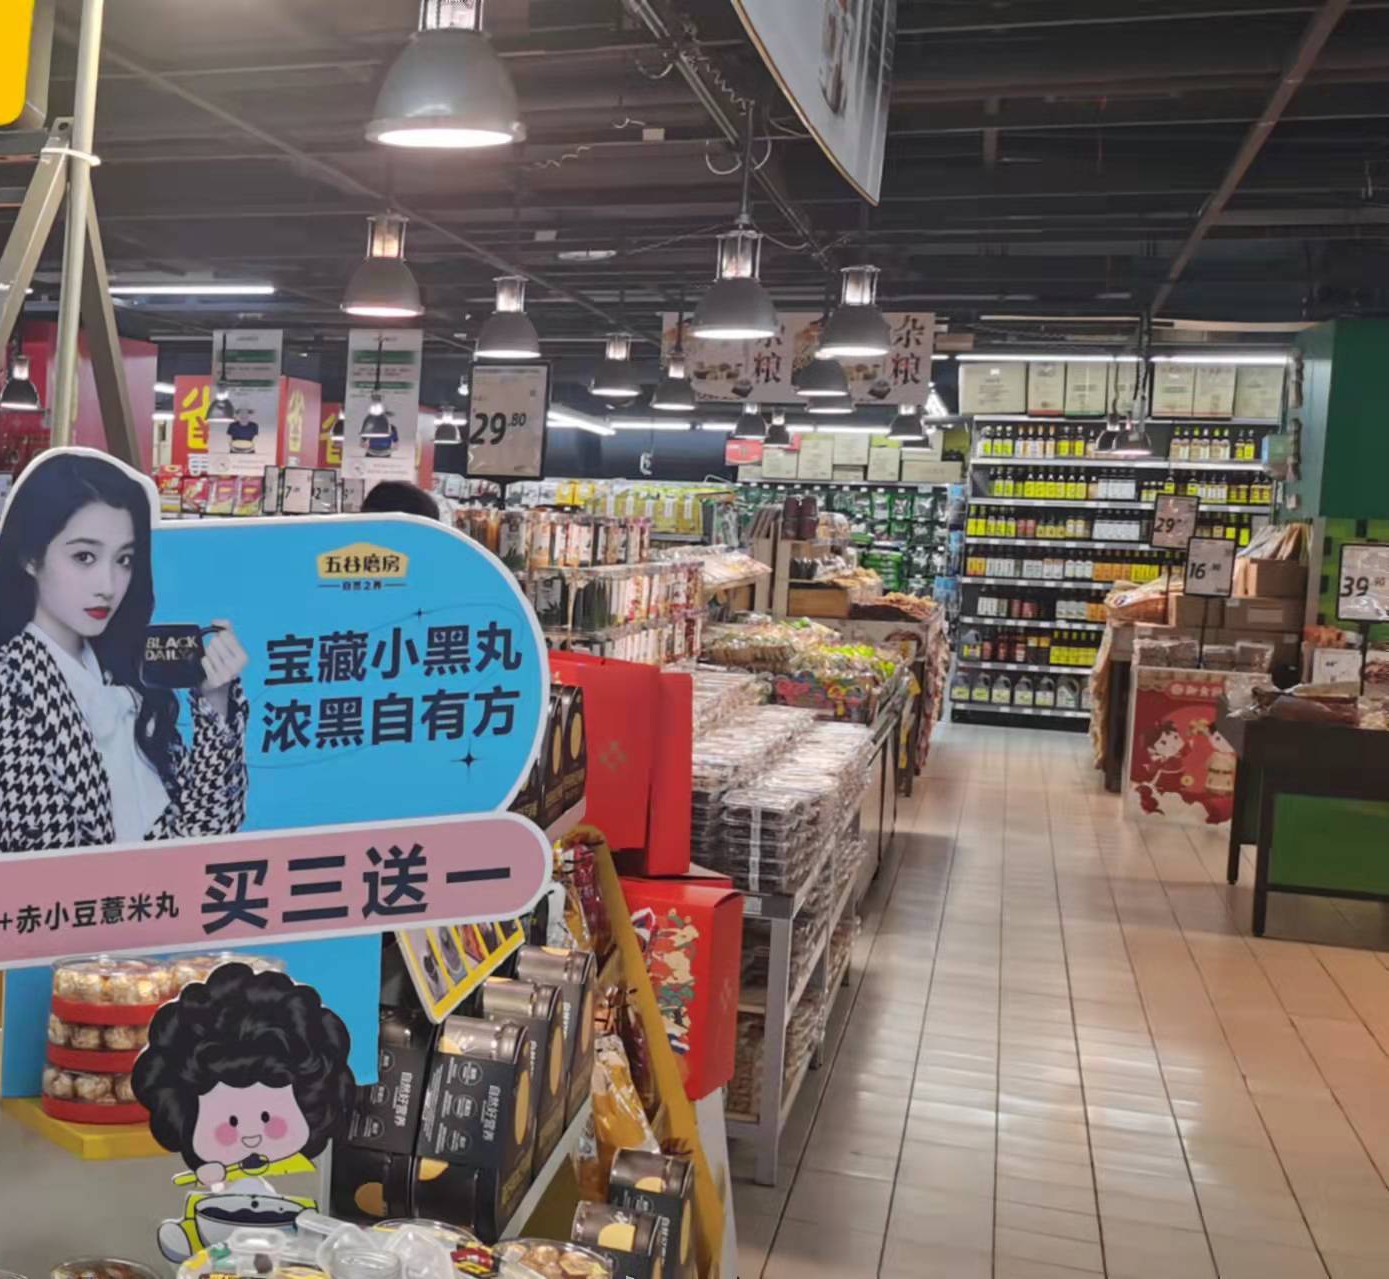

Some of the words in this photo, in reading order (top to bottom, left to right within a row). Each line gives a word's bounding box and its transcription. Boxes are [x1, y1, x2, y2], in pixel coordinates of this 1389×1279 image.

[324, 553, 401, 574] 五谷磨房
[146, 635, 199, 650] BLACK
[264, 620, 523, 686] 宝藏小黑丸
[261, 685, 520, 753] 浓黑自有方
[201, 842, 512, 935] 买三送一
